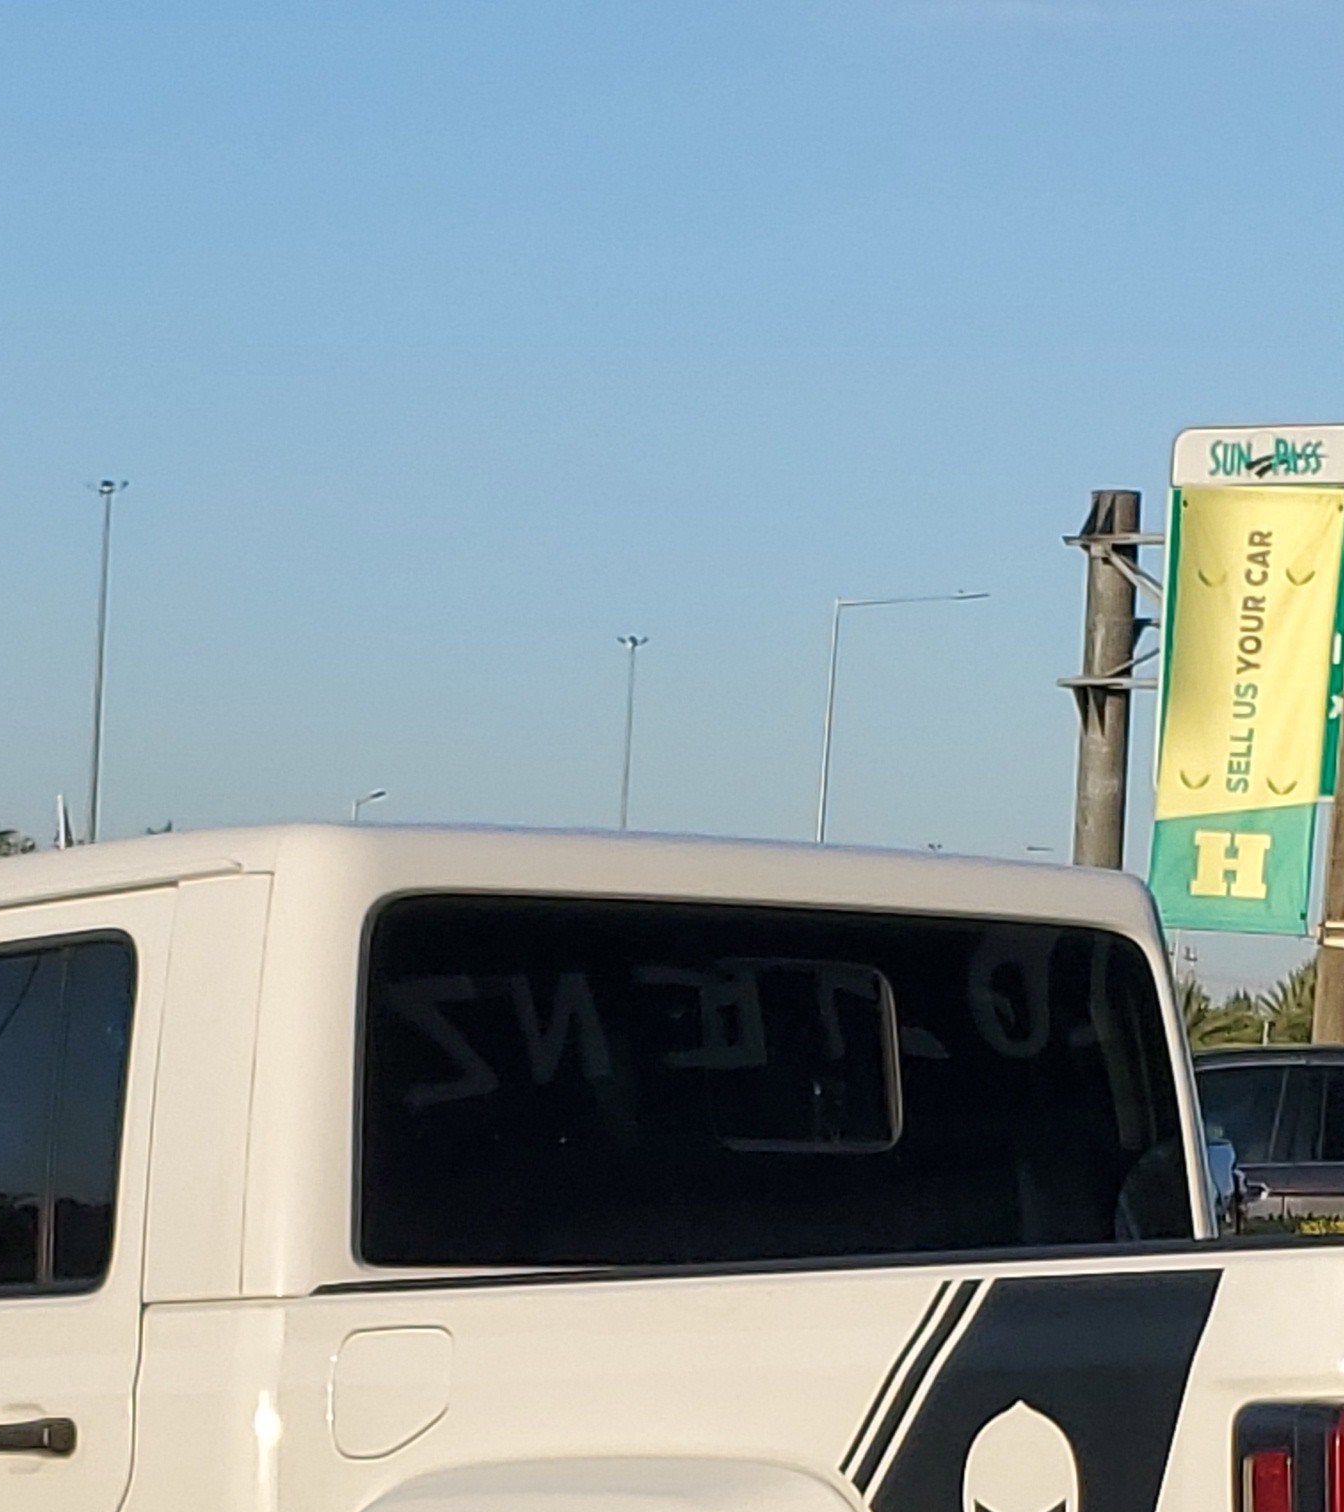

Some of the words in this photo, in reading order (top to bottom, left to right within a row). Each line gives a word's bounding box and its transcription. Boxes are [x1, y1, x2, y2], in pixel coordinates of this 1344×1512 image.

[1244, 529, 1274, 588] CAR
[1236, 594, 1266, 675] YOUR
[1232, 683, 1258, 719] US
[1226, 728, 1254, 793] SELL
[1190, 829, 1272, 899] H
